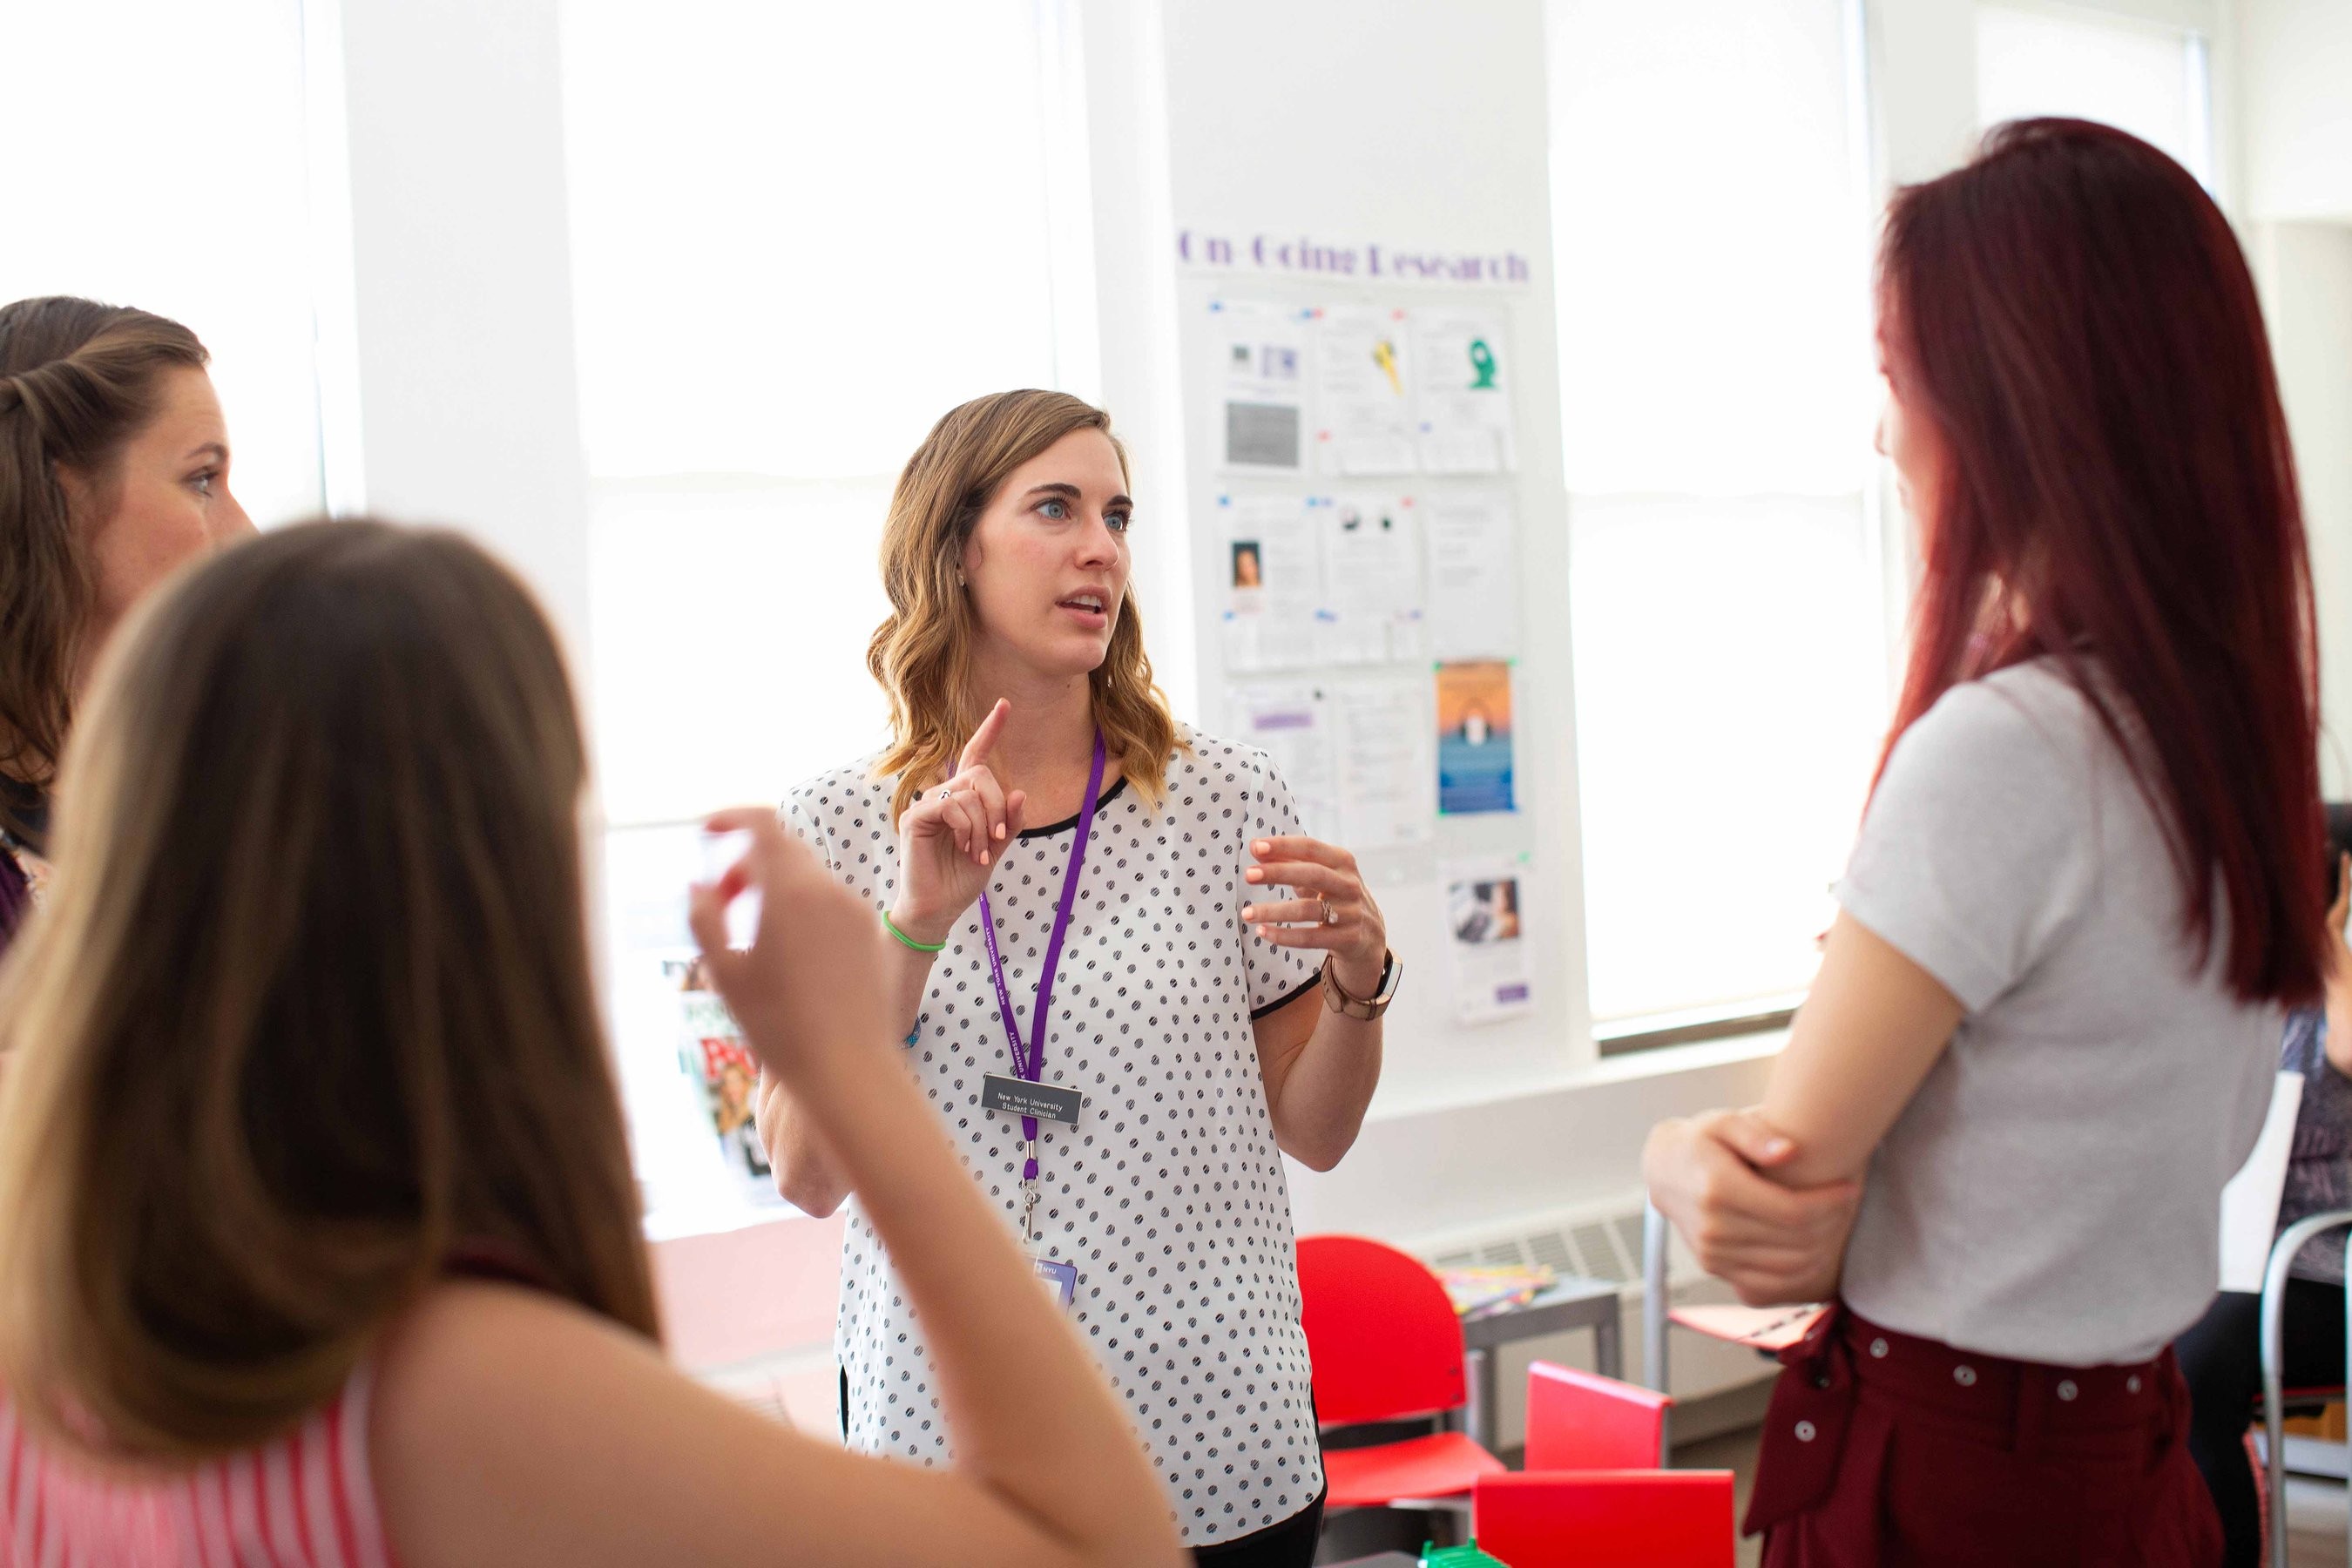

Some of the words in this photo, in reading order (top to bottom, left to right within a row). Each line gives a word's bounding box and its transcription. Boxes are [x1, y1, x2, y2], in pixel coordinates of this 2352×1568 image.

[1369, 242, 1530, 281] Research
[1009, 1031, 1024, 1072] UNIVERSITY
[997, 1092, 1010, 1101] New
[1014, 1095, 1027, 1105] York
[1030, 1098, 1063, 1112] University
[1002, 1102, 1027, 1113] Student
[1030, 1108, 1056, 1119] Clinician
